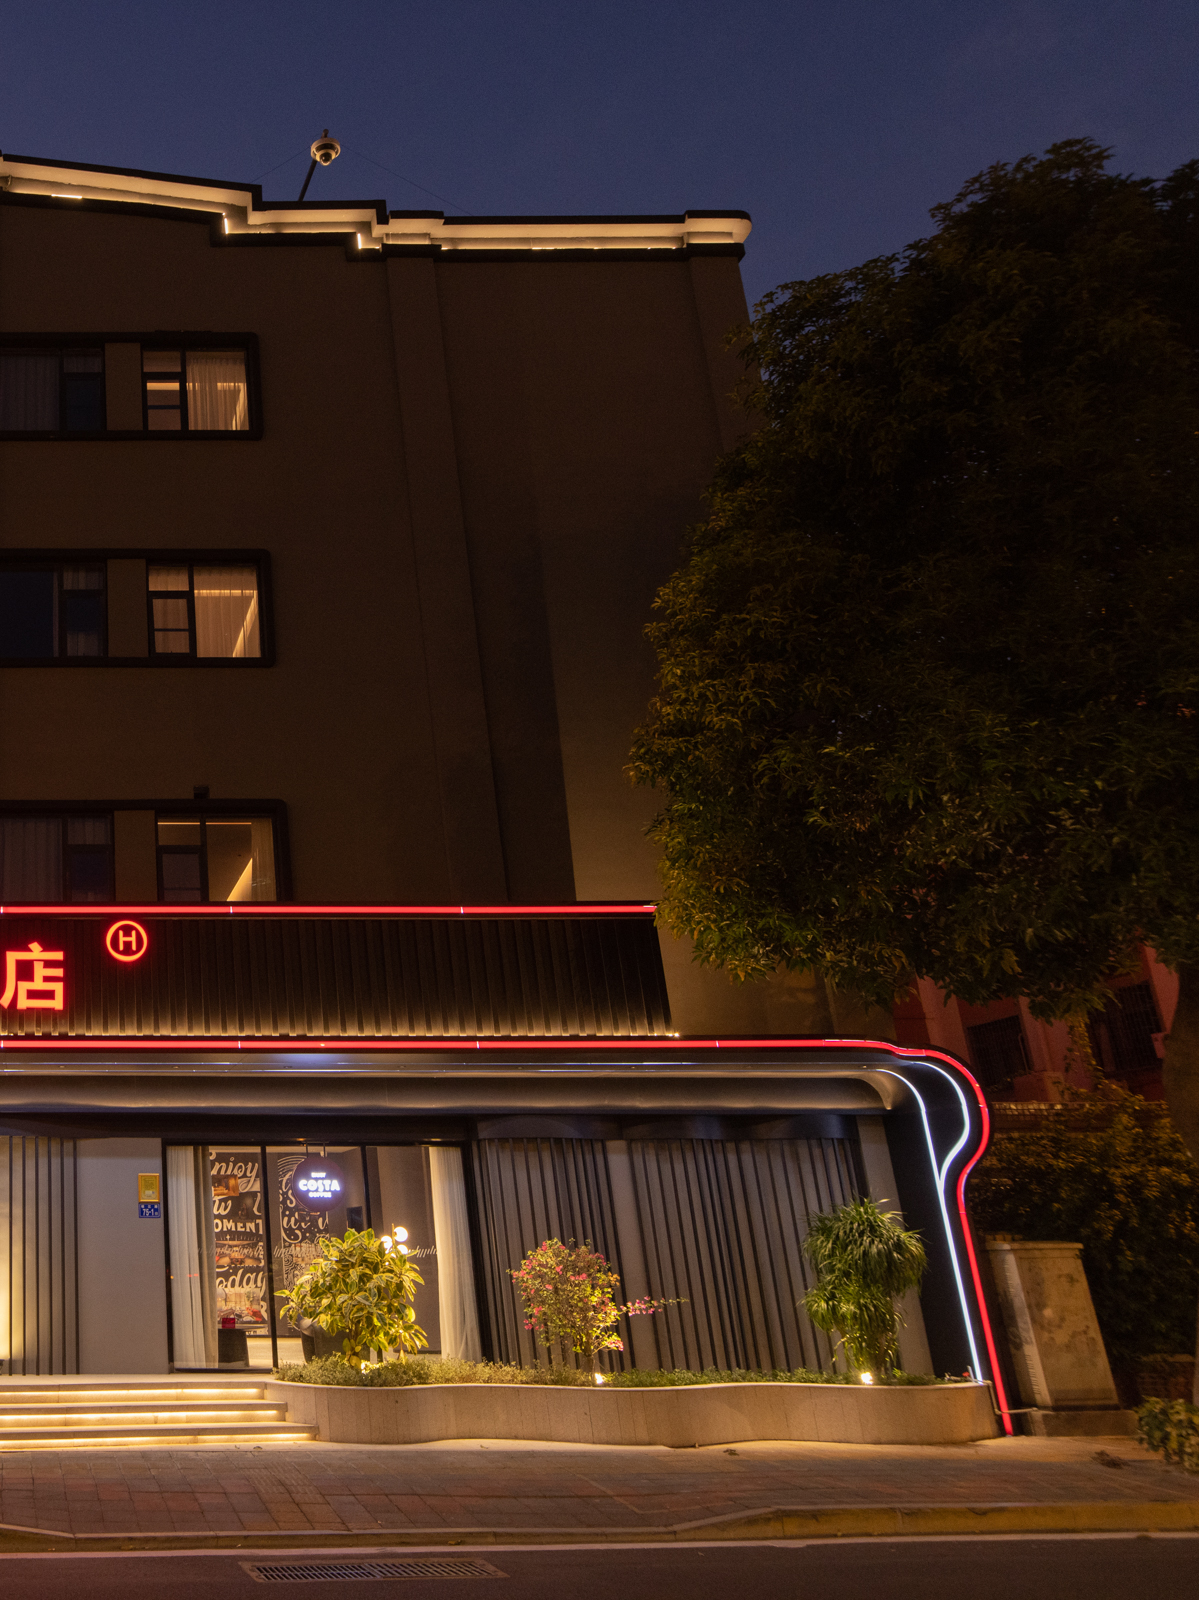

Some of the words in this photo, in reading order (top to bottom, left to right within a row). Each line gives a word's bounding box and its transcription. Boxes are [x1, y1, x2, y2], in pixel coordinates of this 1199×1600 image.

[210, 1152, 259, 1193] njoy
[299, 1179, 341, 1193] COSTA
[215, 1267, 266, 1299] oday
